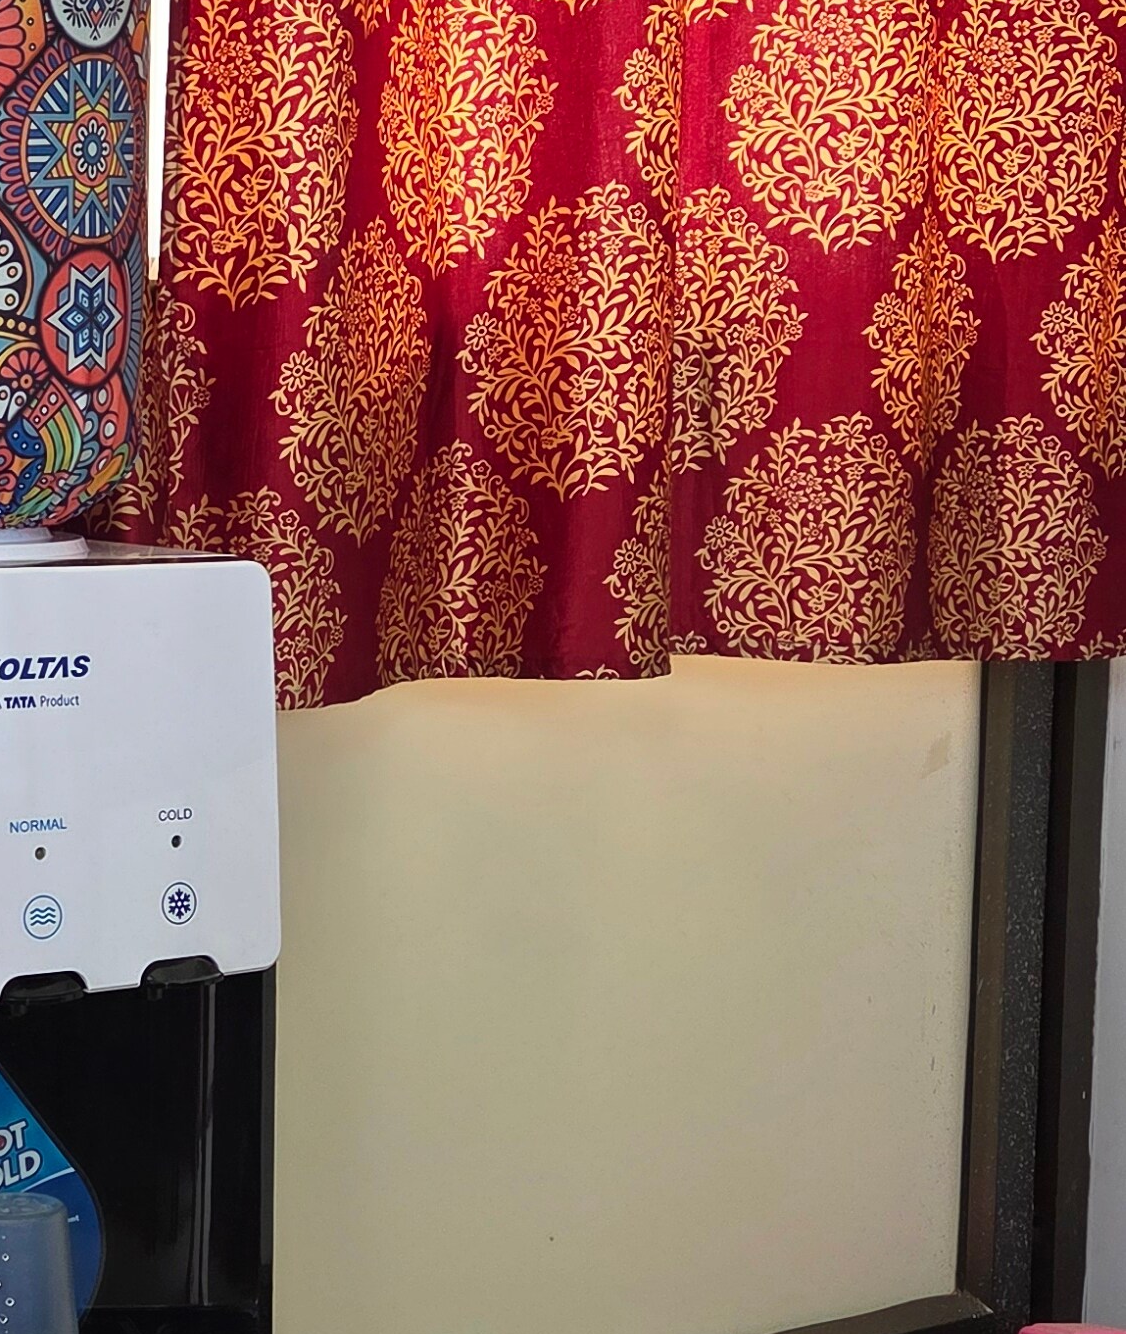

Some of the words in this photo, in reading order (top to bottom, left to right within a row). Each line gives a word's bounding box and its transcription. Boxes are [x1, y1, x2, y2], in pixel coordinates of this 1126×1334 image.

[4, 696, 36, 709] TATA
[40, 694, 80, 707] Product
[158, 808, 193, 822] COLD
[9, 818, 68, 833] NORMAL
